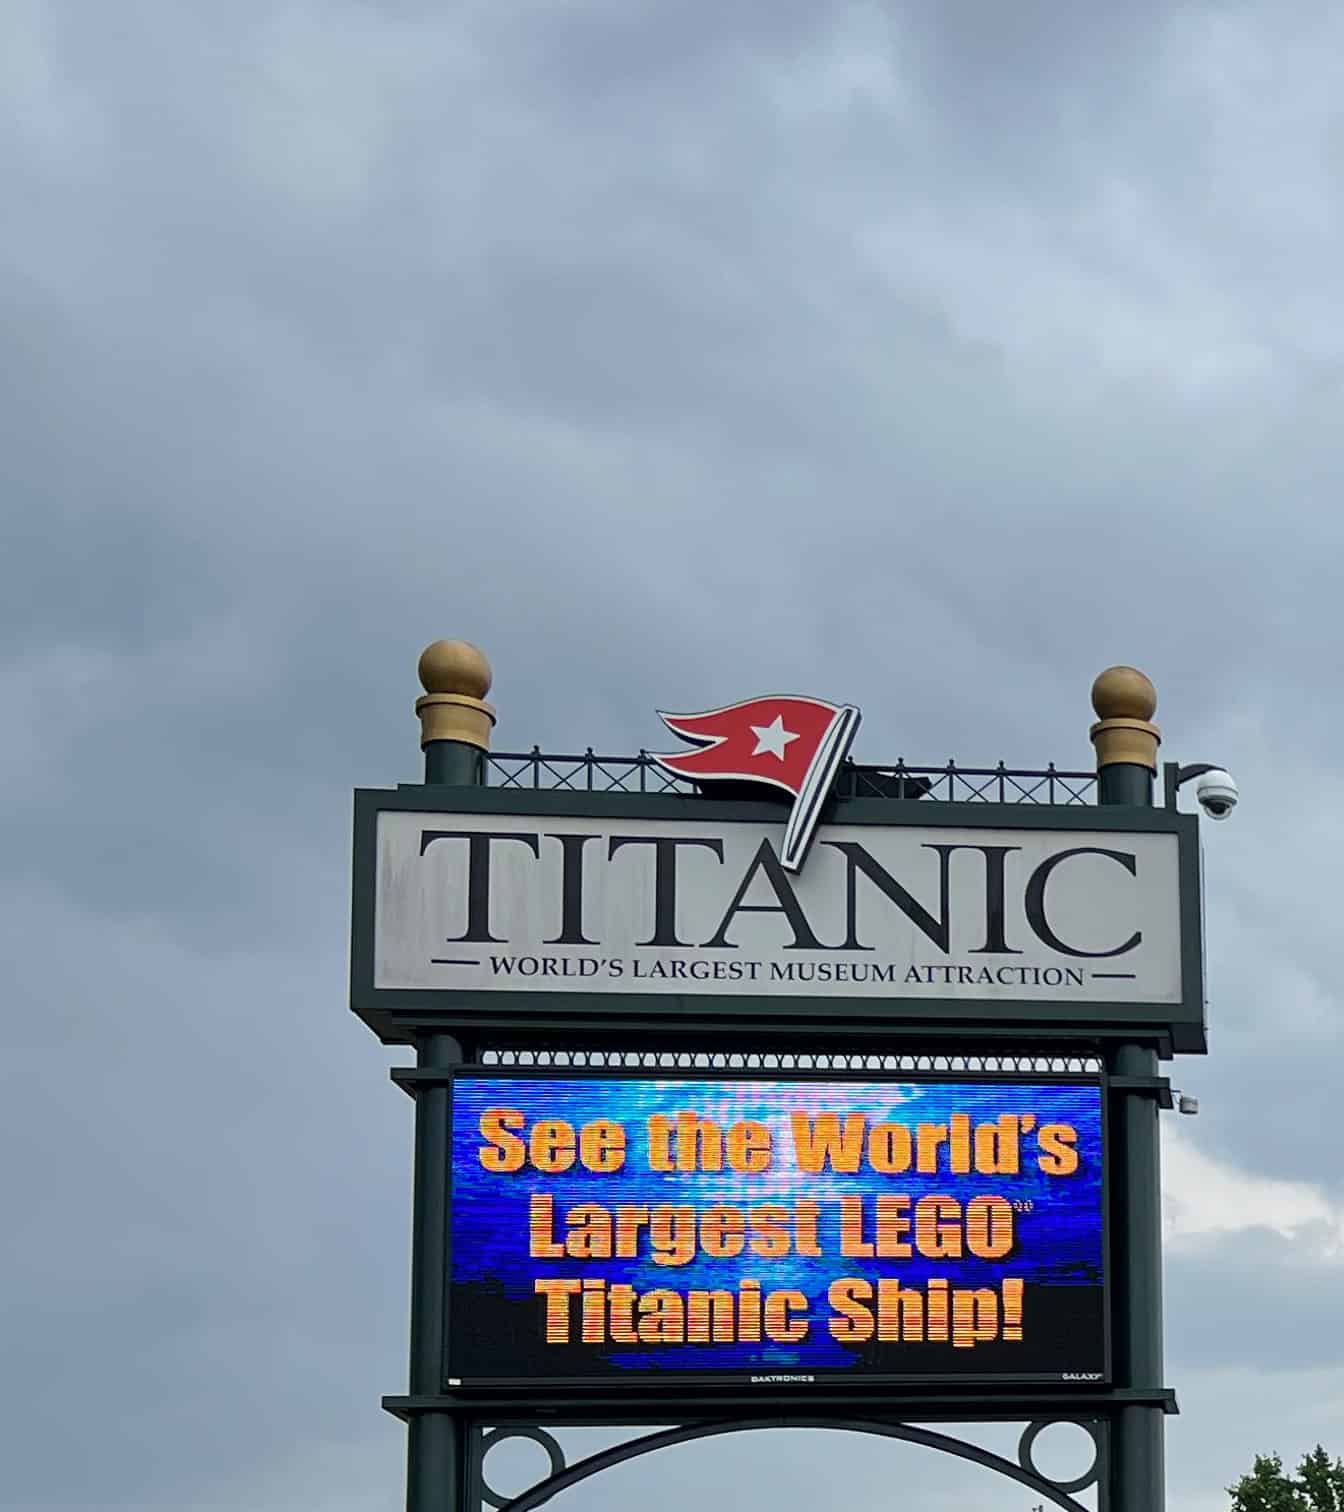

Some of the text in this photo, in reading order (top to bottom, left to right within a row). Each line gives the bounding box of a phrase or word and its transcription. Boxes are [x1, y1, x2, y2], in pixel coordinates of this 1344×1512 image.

[420, 829, 1142, 958] TITANIC
[490, 956, 1084, 986] WORLD'S LARGEST MUSEUM ATTRACTION
[478, 1108, 1079, 1176] See the World's
[529, 1194, 822, 1266] Largest
[534, 1277, 1024, 1348] Titanic Ship!
